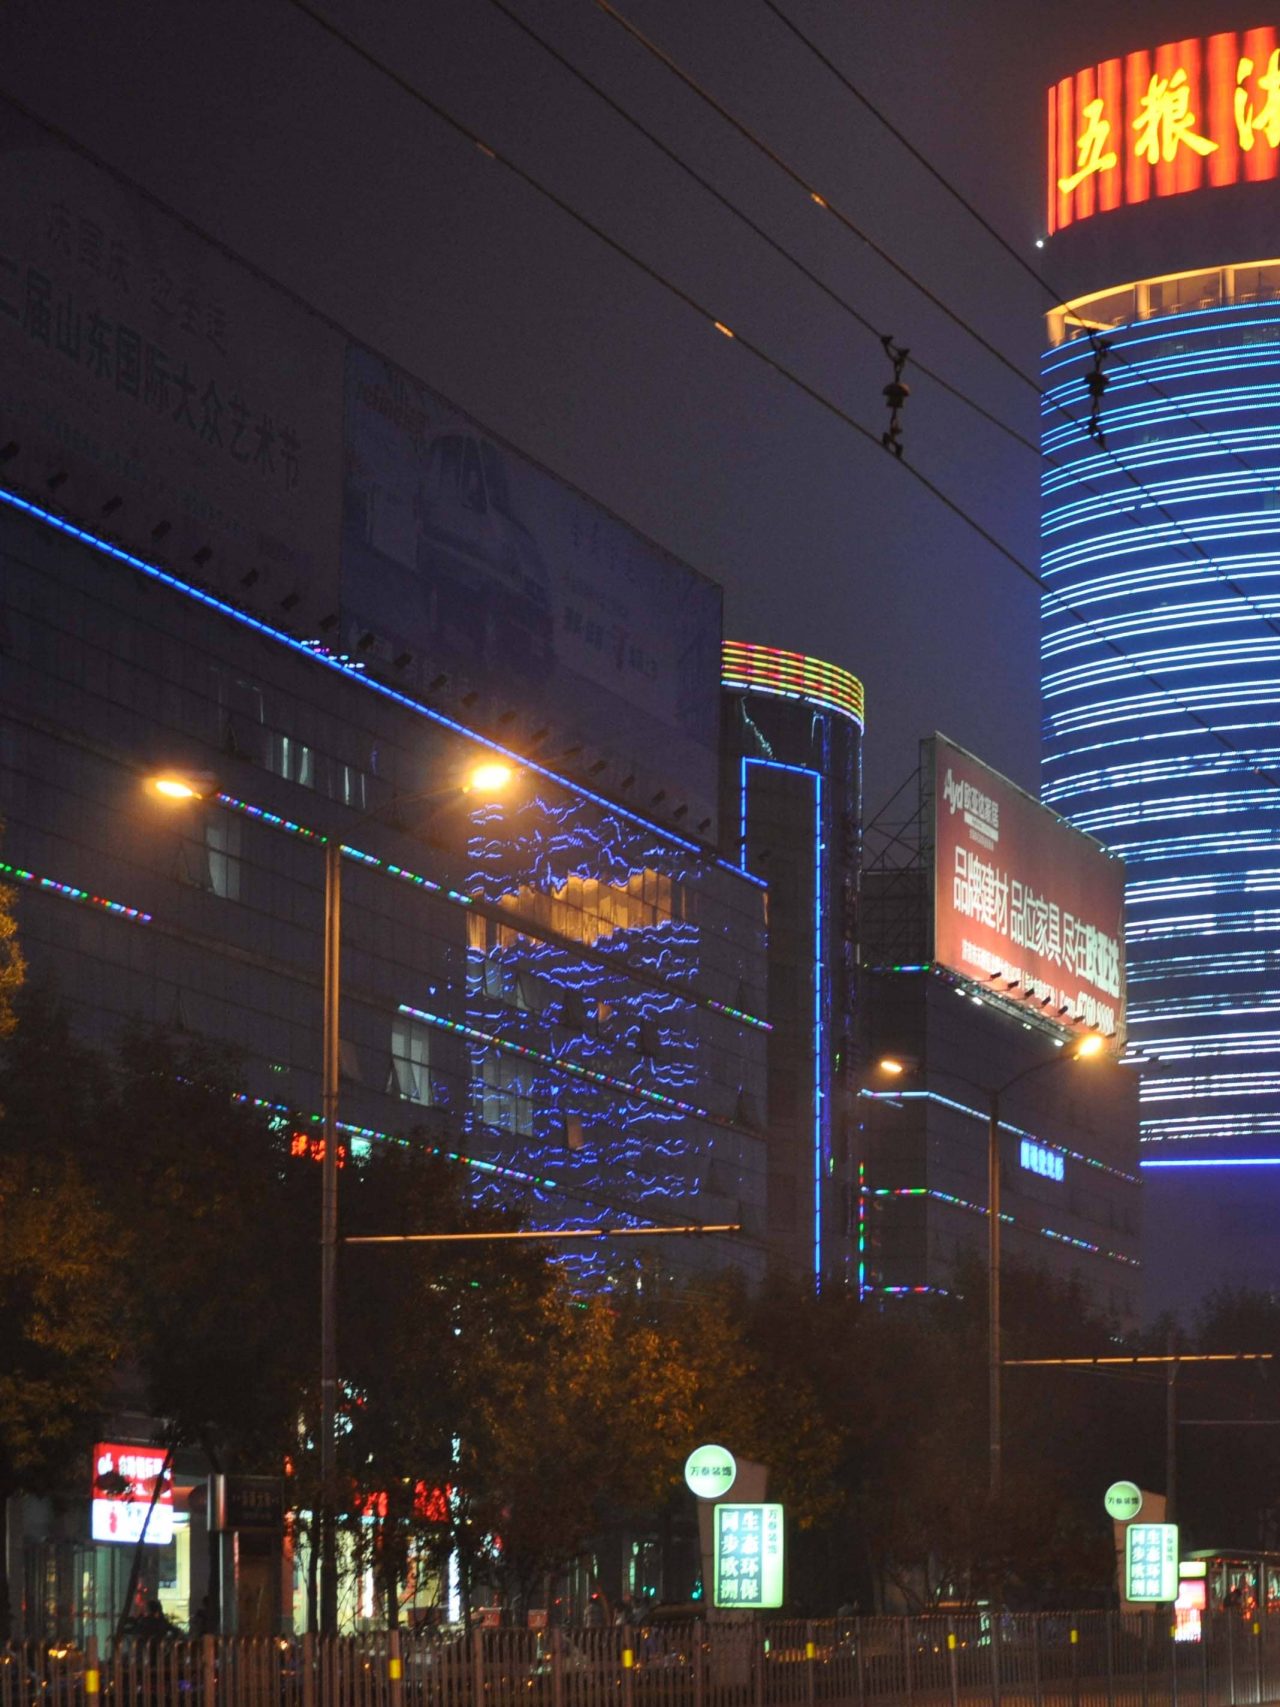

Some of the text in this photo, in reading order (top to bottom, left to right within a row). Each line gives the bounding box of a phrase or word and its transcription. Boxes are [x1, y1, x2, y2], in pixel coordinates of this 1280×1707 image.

[954, 846, 1009, 936] 品牌建材
[1010, 880, 1062, 967] 品位家具
[740, 1511, 760, 1600] 生态环保
